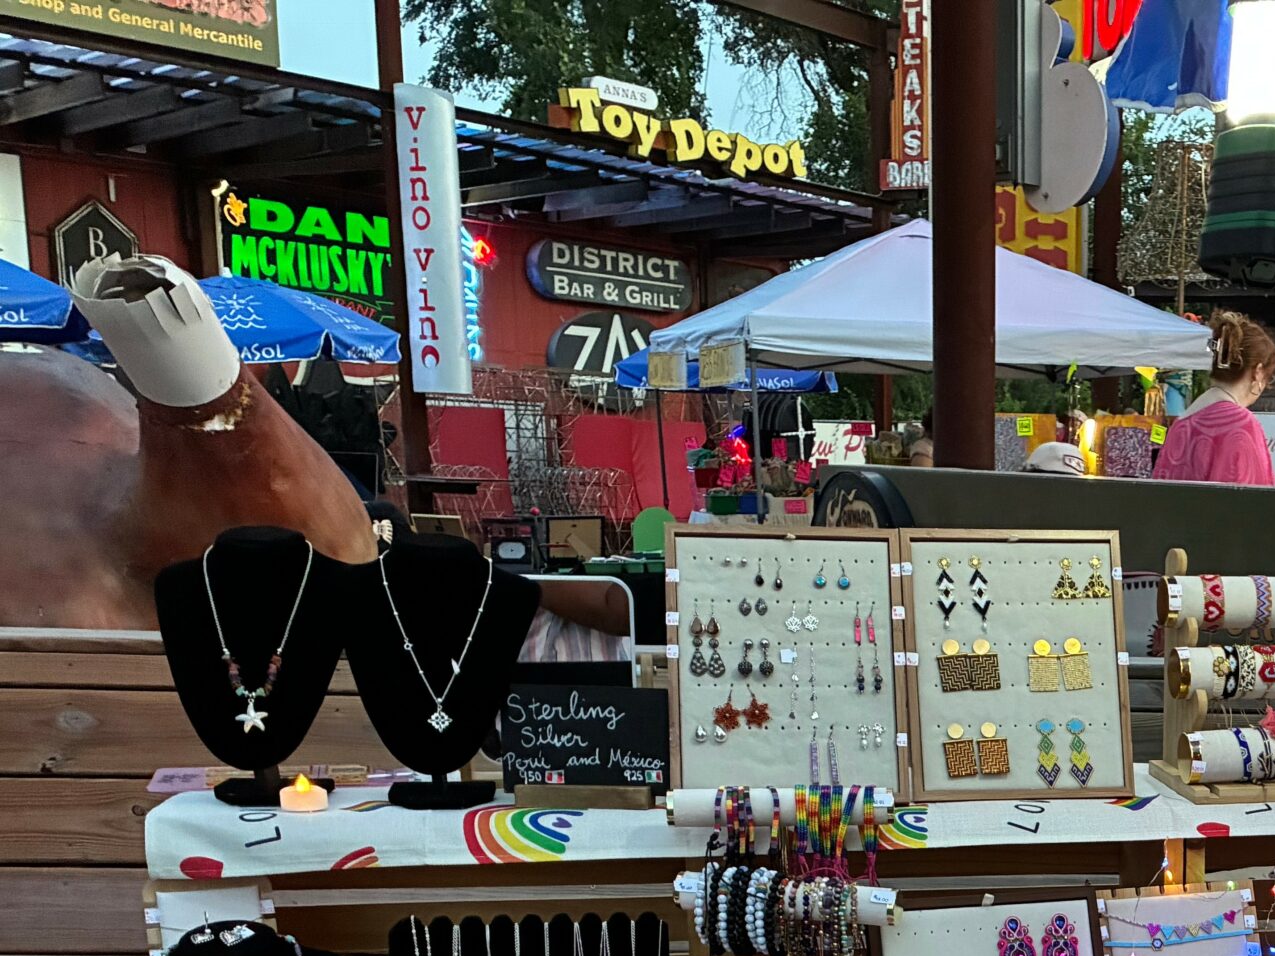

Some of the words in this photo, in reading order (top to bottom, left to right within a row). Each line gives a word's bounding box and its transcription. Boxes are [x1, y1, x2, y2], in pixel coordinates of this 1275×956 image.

[70, 2, 102, 19] and
[109, 10, 174, 33] General
[180, 22, 263, 51] Mercantile
[603, 83, 648, 103] ANNA'S
[902, 0, 922, 156] TEAKS
[567, 87, 661, 158] Toy
[669, 117, 808, 179] Depot
[249, 197, 391, 248] DAN
[89, 226, 108, 259] B
[552, 242, 680, 281] DISTRICT
[602, 282, 620, 302] &
[843, 428, 868, 461] P
[506, 690, 626, 730] Sterling
[520, 724, 589, 748] Silver
[566, 747, 601, 767] and
[623, 769, 644, 783] 925
